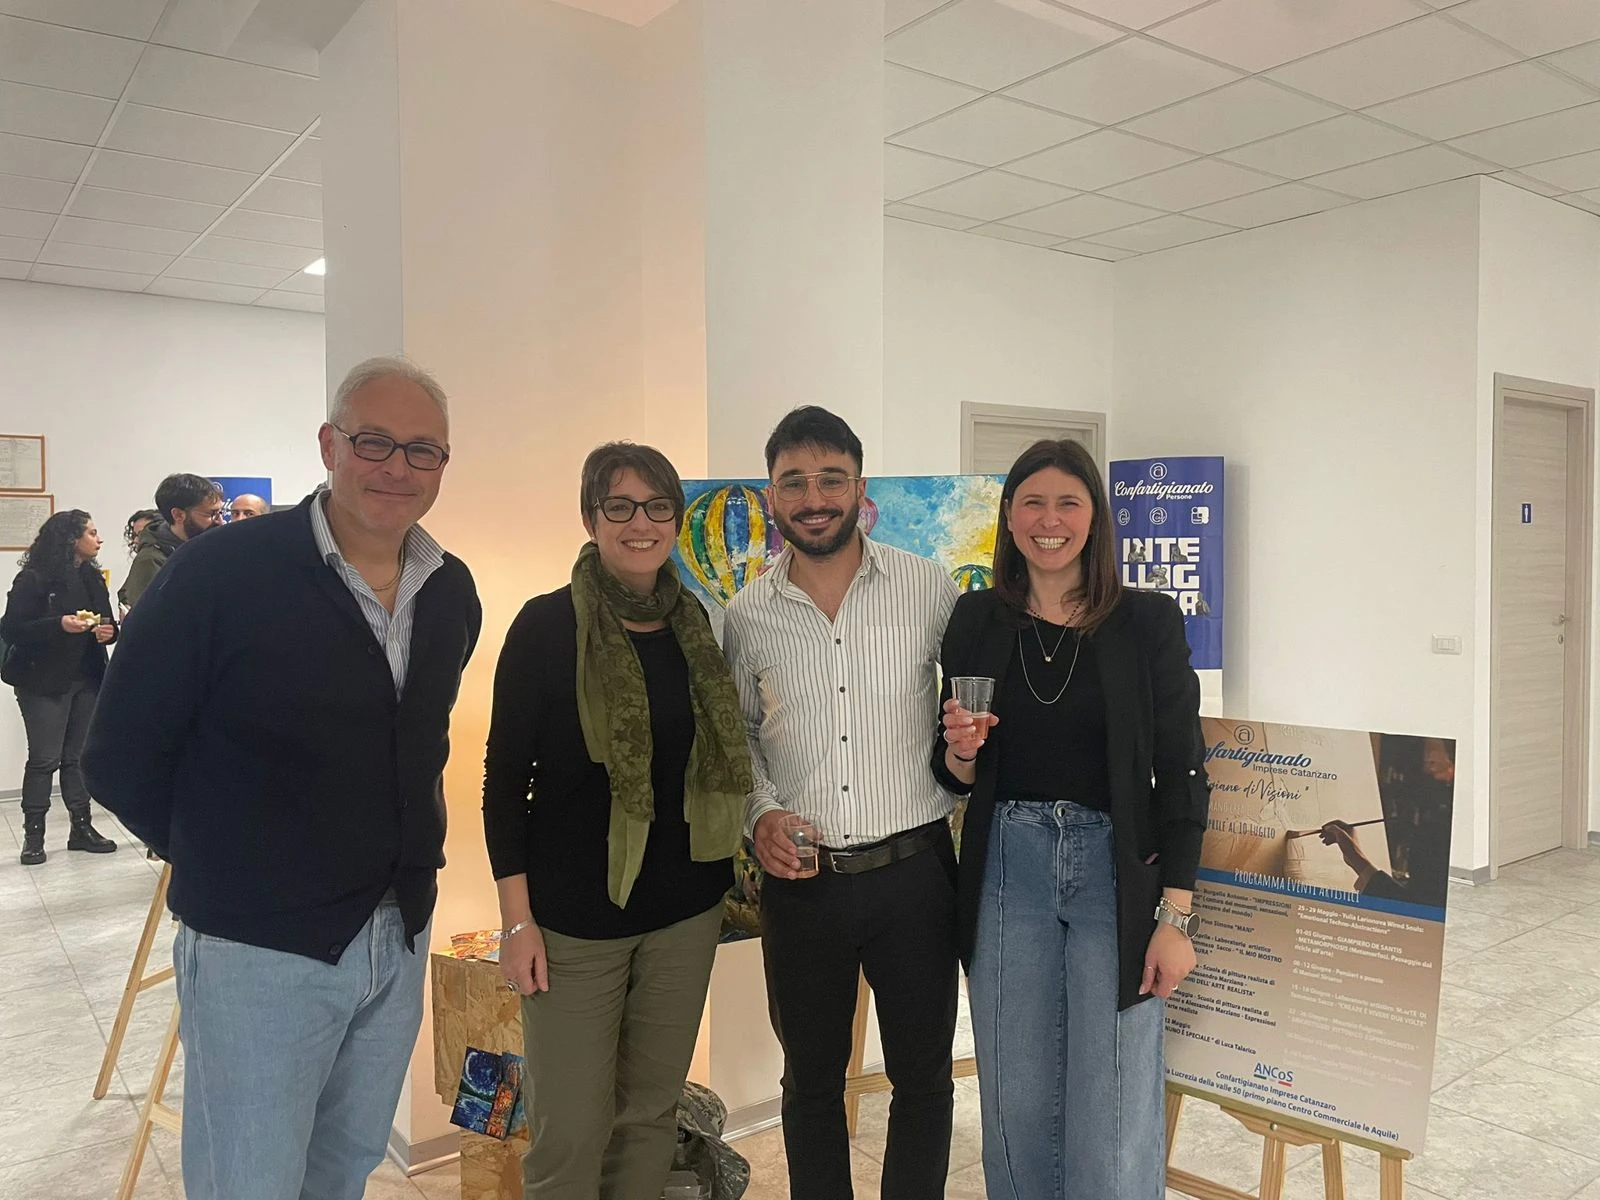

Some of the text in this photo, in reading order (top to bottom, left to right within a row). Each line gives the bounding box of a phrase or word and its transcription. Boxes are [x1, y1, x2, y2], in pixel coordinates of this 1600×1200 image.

[1114, 479, 1214, 500] Confartigianato
[1122, 538, 1200, 562] INTE
[1122, 564, 1200, 589] LLIG
[1205, 741, 1312, 768] fartigianato
[1252, 764, 1338, 780] Imprese Catanzaro
[1256, 778, 1302, 802] Visioni
[1207, 818, 1276, 840] PRILE AL 10 LUGLIO
[1234, 868, 1360, 904] PROGRAMMA EVENTI ARTISTICI
[1254, 1062, 1294, 1082] ANCoS
[1216, 1071, 1269, 1093] Confartigianato
[1270, 1086, 1298, 1100] Imprese
[1300, 1095, 1336, 1111] Catanzaro
[1171, 1068, 1197, 1082] Lucrezia
[1199, 1077, 1214, 1087] della
[1216, 1083, 1231, 1092] valle
[1233, 1086, 1242, 1095] 50
[1242, 1089, 1265, 1102] (primo
[1266, 1096, 1286, 1108] piano
[1288, 1103, 1312, 1115] Centro
[1313, 1110, 1362, 1130] Commerciale
[1362, 1124, 1370, 1132] le
[1371, 1126, 1399, 1141] Aquile)
